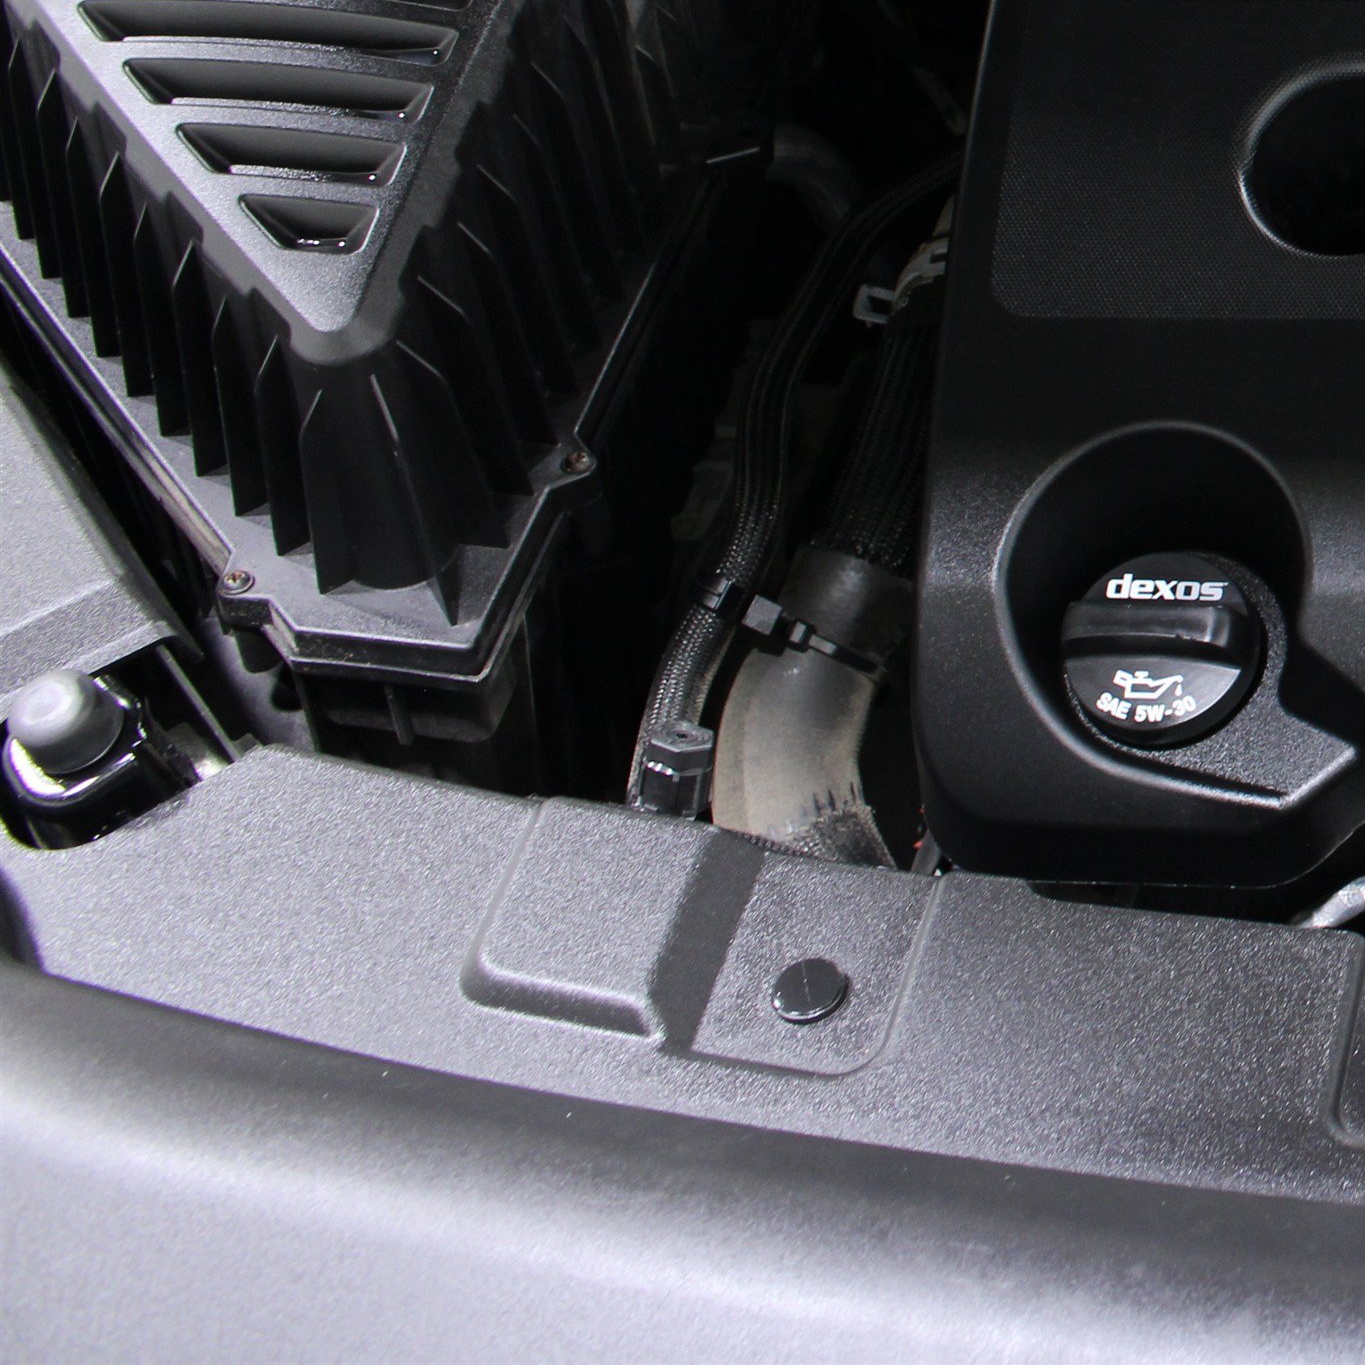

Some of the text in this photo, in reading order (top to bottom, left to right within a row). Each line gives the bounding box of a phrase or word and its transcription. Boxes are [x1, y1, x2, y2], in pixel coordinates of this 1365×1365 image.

[1106, 573, 1226, 602] dexos
[1096, 692, 1197, 723] SAE 5W-30
